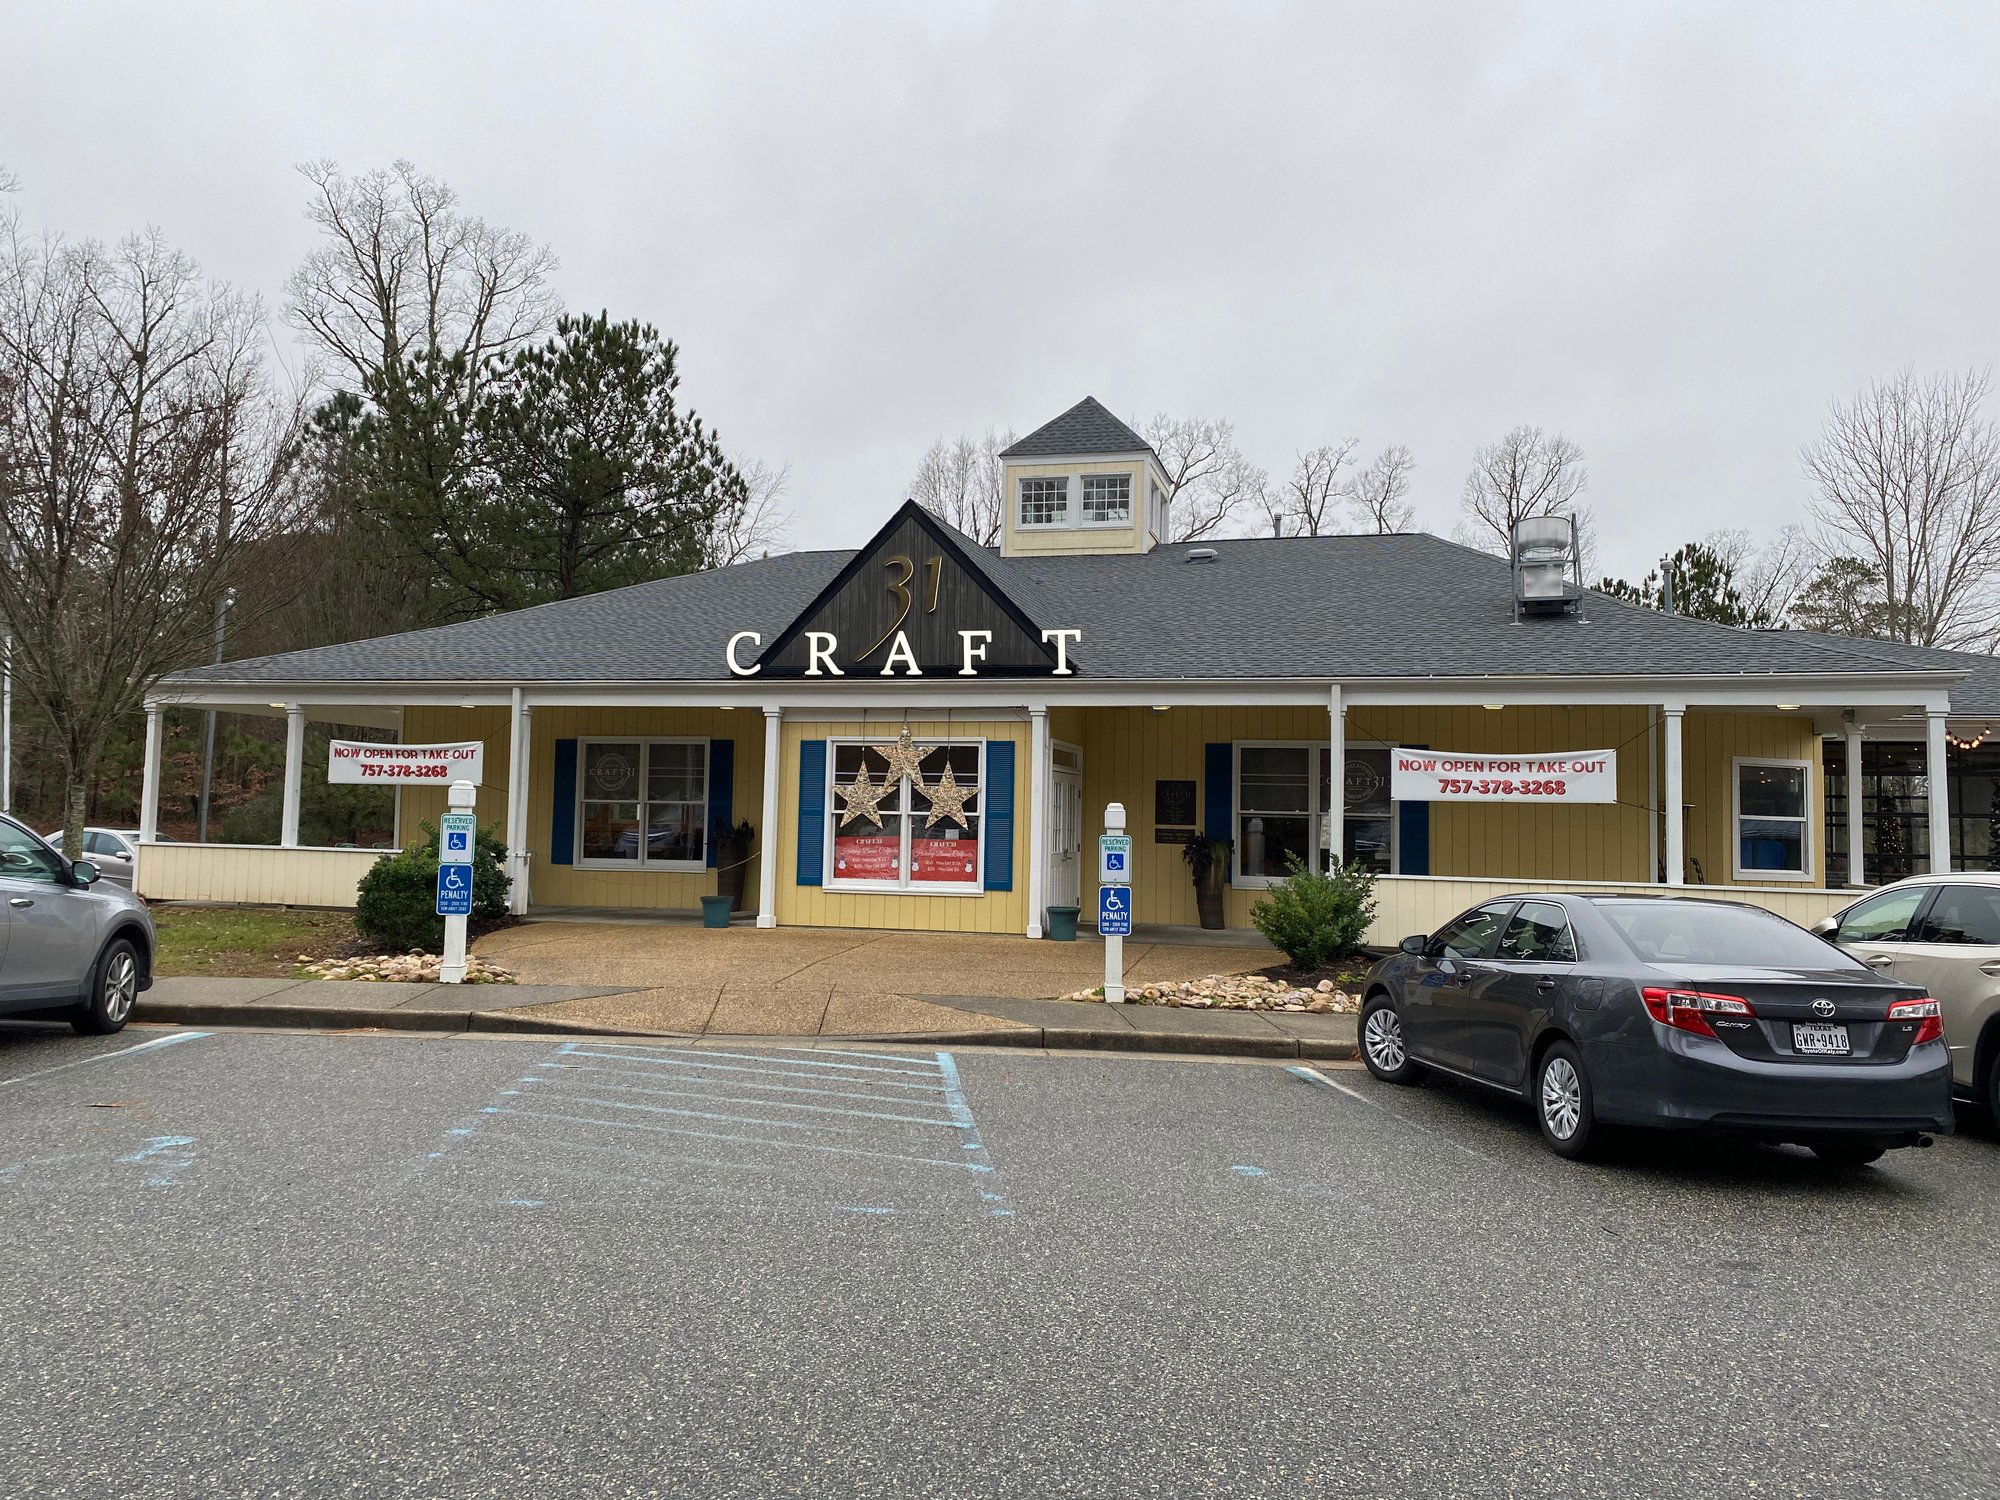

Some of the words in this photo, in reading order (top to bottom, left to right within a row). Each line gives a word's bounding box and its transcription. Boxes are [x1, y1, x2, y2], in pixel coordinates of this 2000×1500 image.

[855, 555, 943, 662] 31
[726, 629, 1082, 677] CRAFT
[334, 748, 360, 758] NOW
[364, 749, 393, 759] OPEN
[396, 750, 418, 759] FOR
[421, 749, 477, 760] TAKE-OUT
[360, 764, 448, 778] 757-378-3268
[1398, 760, 1437, 772] NOW
[1441, 760, 1484, 772] OPEN
[1488, 761, 1521, 773] FOR
[1526, 760, 1607, 773] TAKE-OUT
[1438, 778, 1566, 795] 757-378-3268
[440, 890, 468, 899] PENALTY
[1102, 912, 1128, 920] PENALTY
